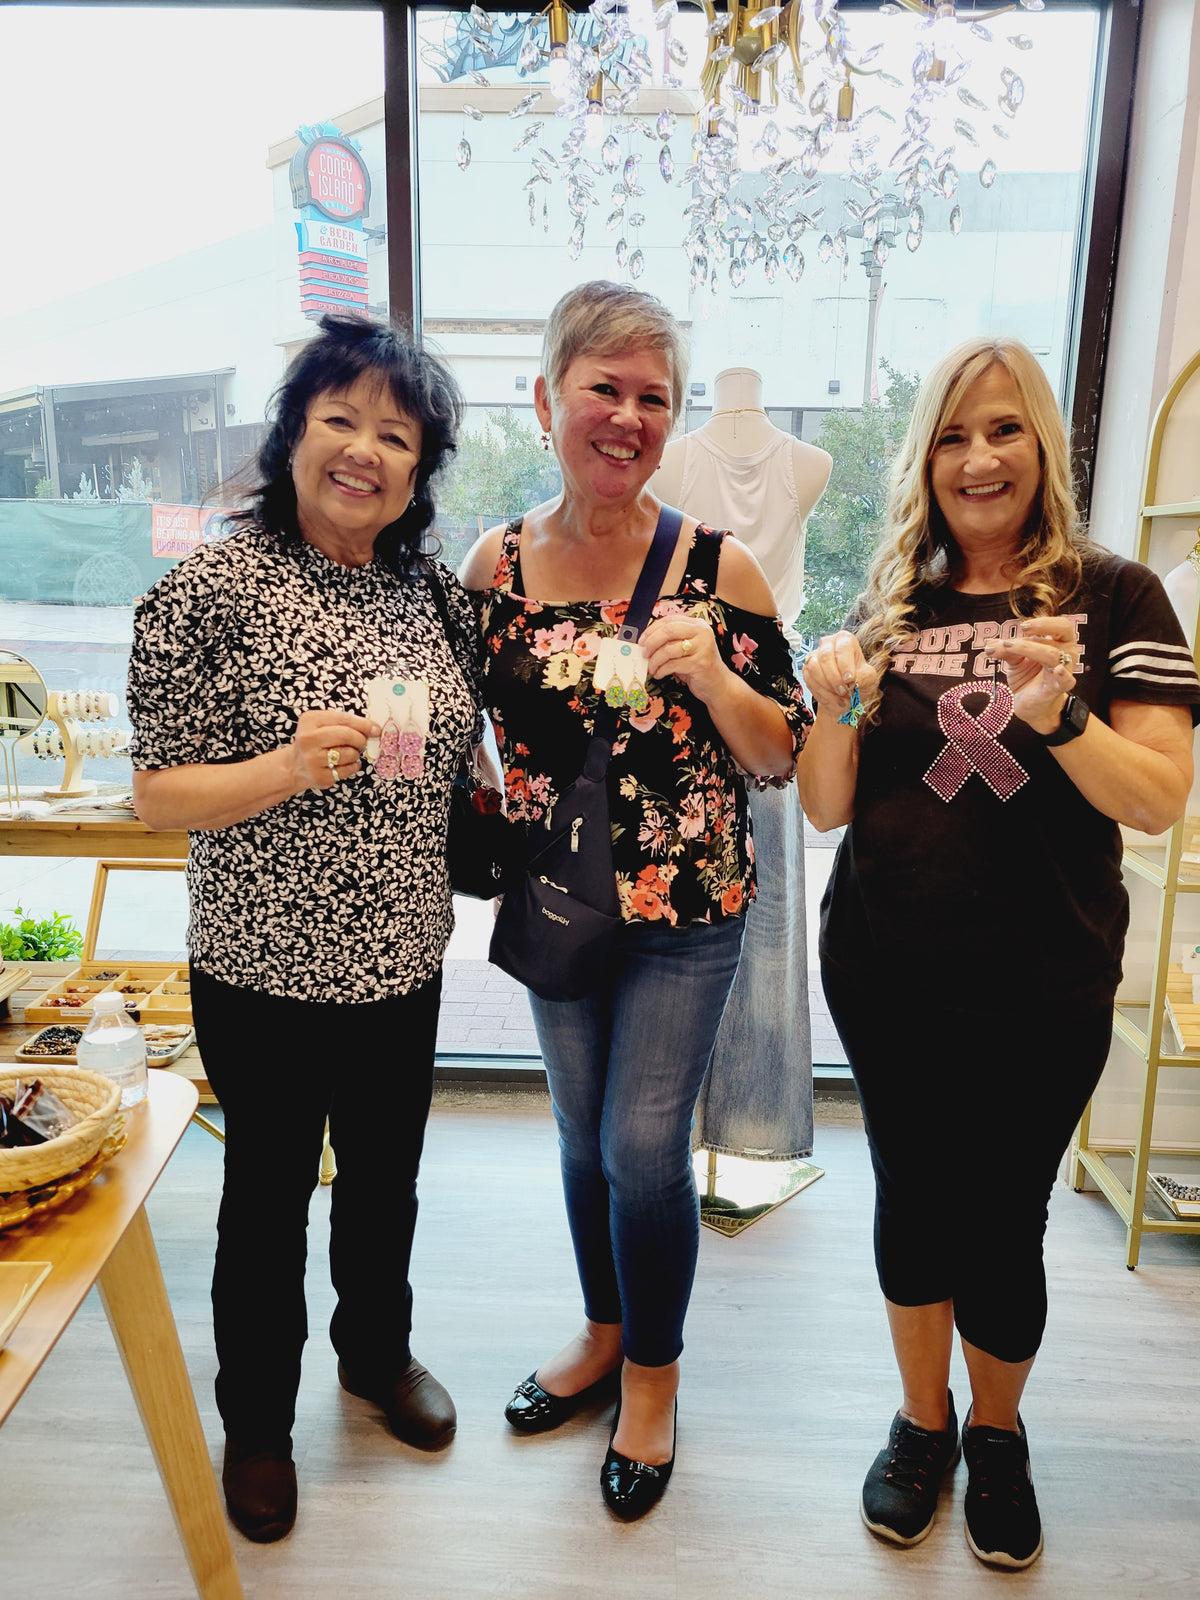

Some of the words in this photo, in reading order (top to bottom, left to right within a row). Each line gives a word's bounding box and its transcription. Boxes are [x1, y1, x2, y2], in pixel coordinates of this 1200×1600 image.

[319, 153, 353, 181] CONEY
[319, 173, 355, 205] ISLAND
[329, 226, 355, 242] BEER
[320, 235, 358, 253] GARDEN
[322, 255, 359, 271] ARCADE
[156, 515, 171, 527] IT'S
[156, 528, 188, 540] GETTING
[189, 530, 200, 541] AN
[888, 653, 966, 677] THE
